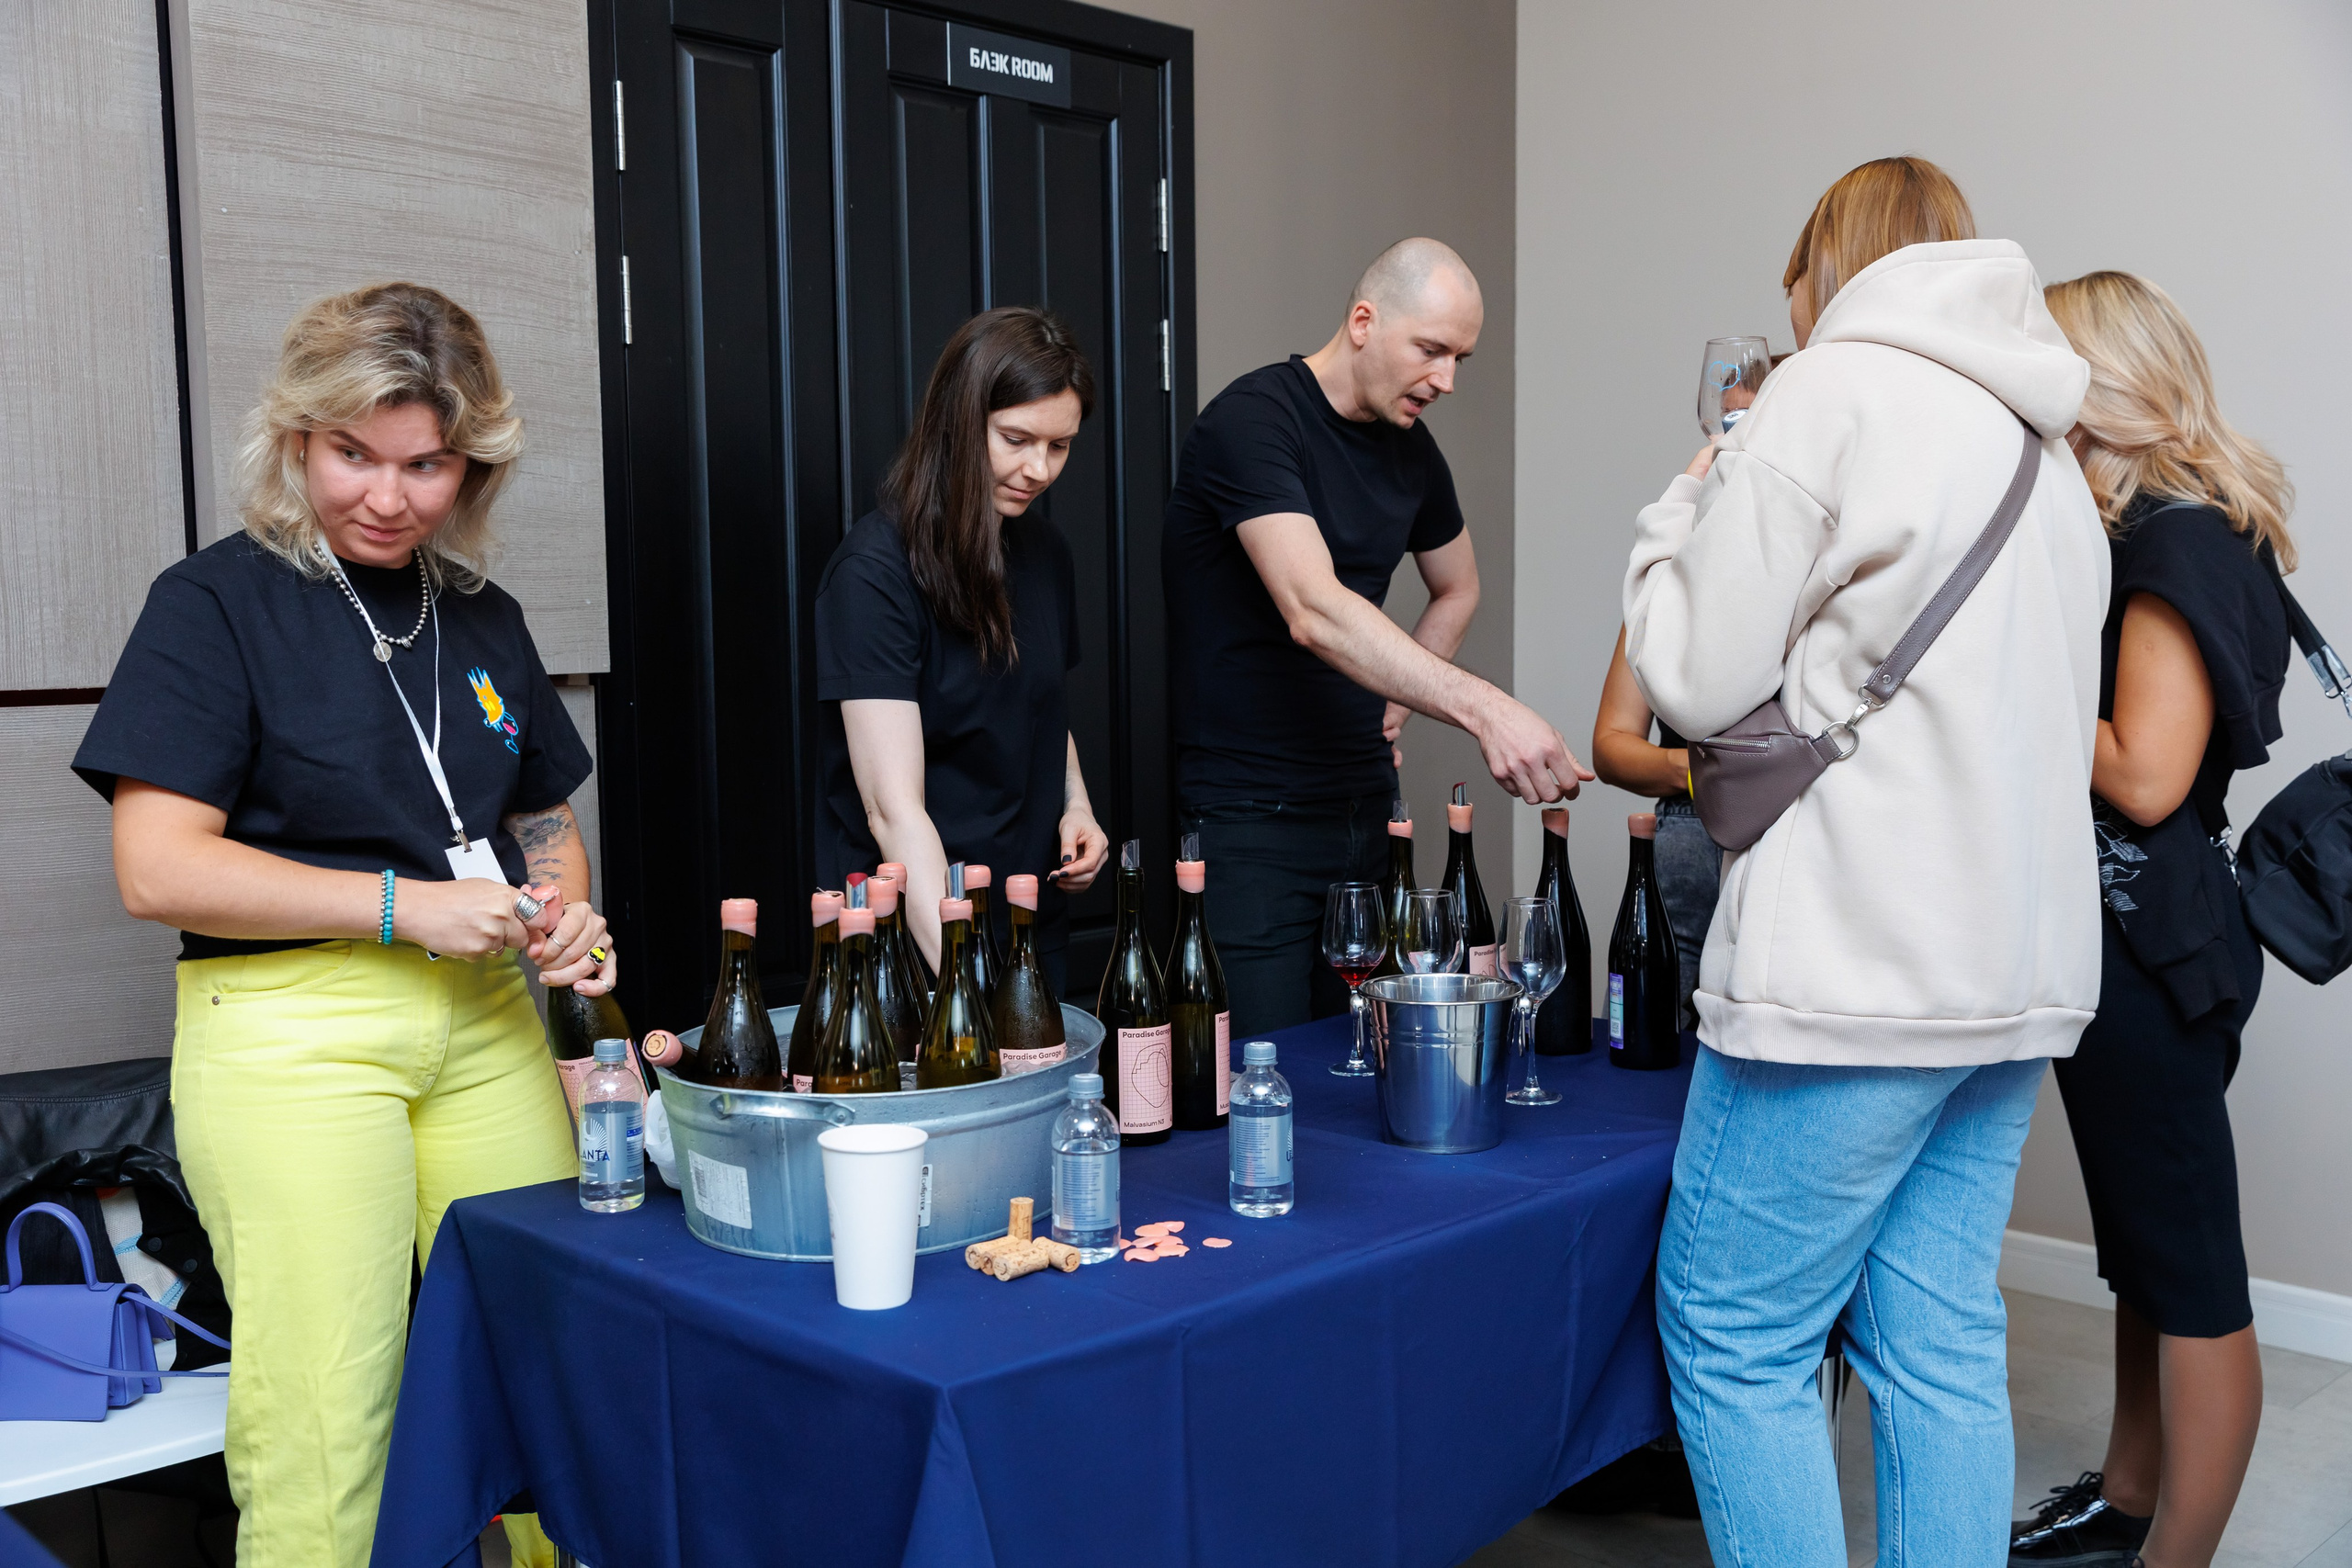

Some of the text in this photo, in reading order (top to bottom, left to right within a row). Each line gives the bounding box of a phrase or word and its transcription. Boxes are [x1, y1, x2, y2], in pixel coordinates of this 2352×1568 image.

[969, 47, 1054, 84] БЛЭК ROOM
[1155, 1028, 1170, 1036] Garag
[1002, 1050, 1062, 1061] Paradise Garage
[580, 1148, 611, 1162] ANTA
